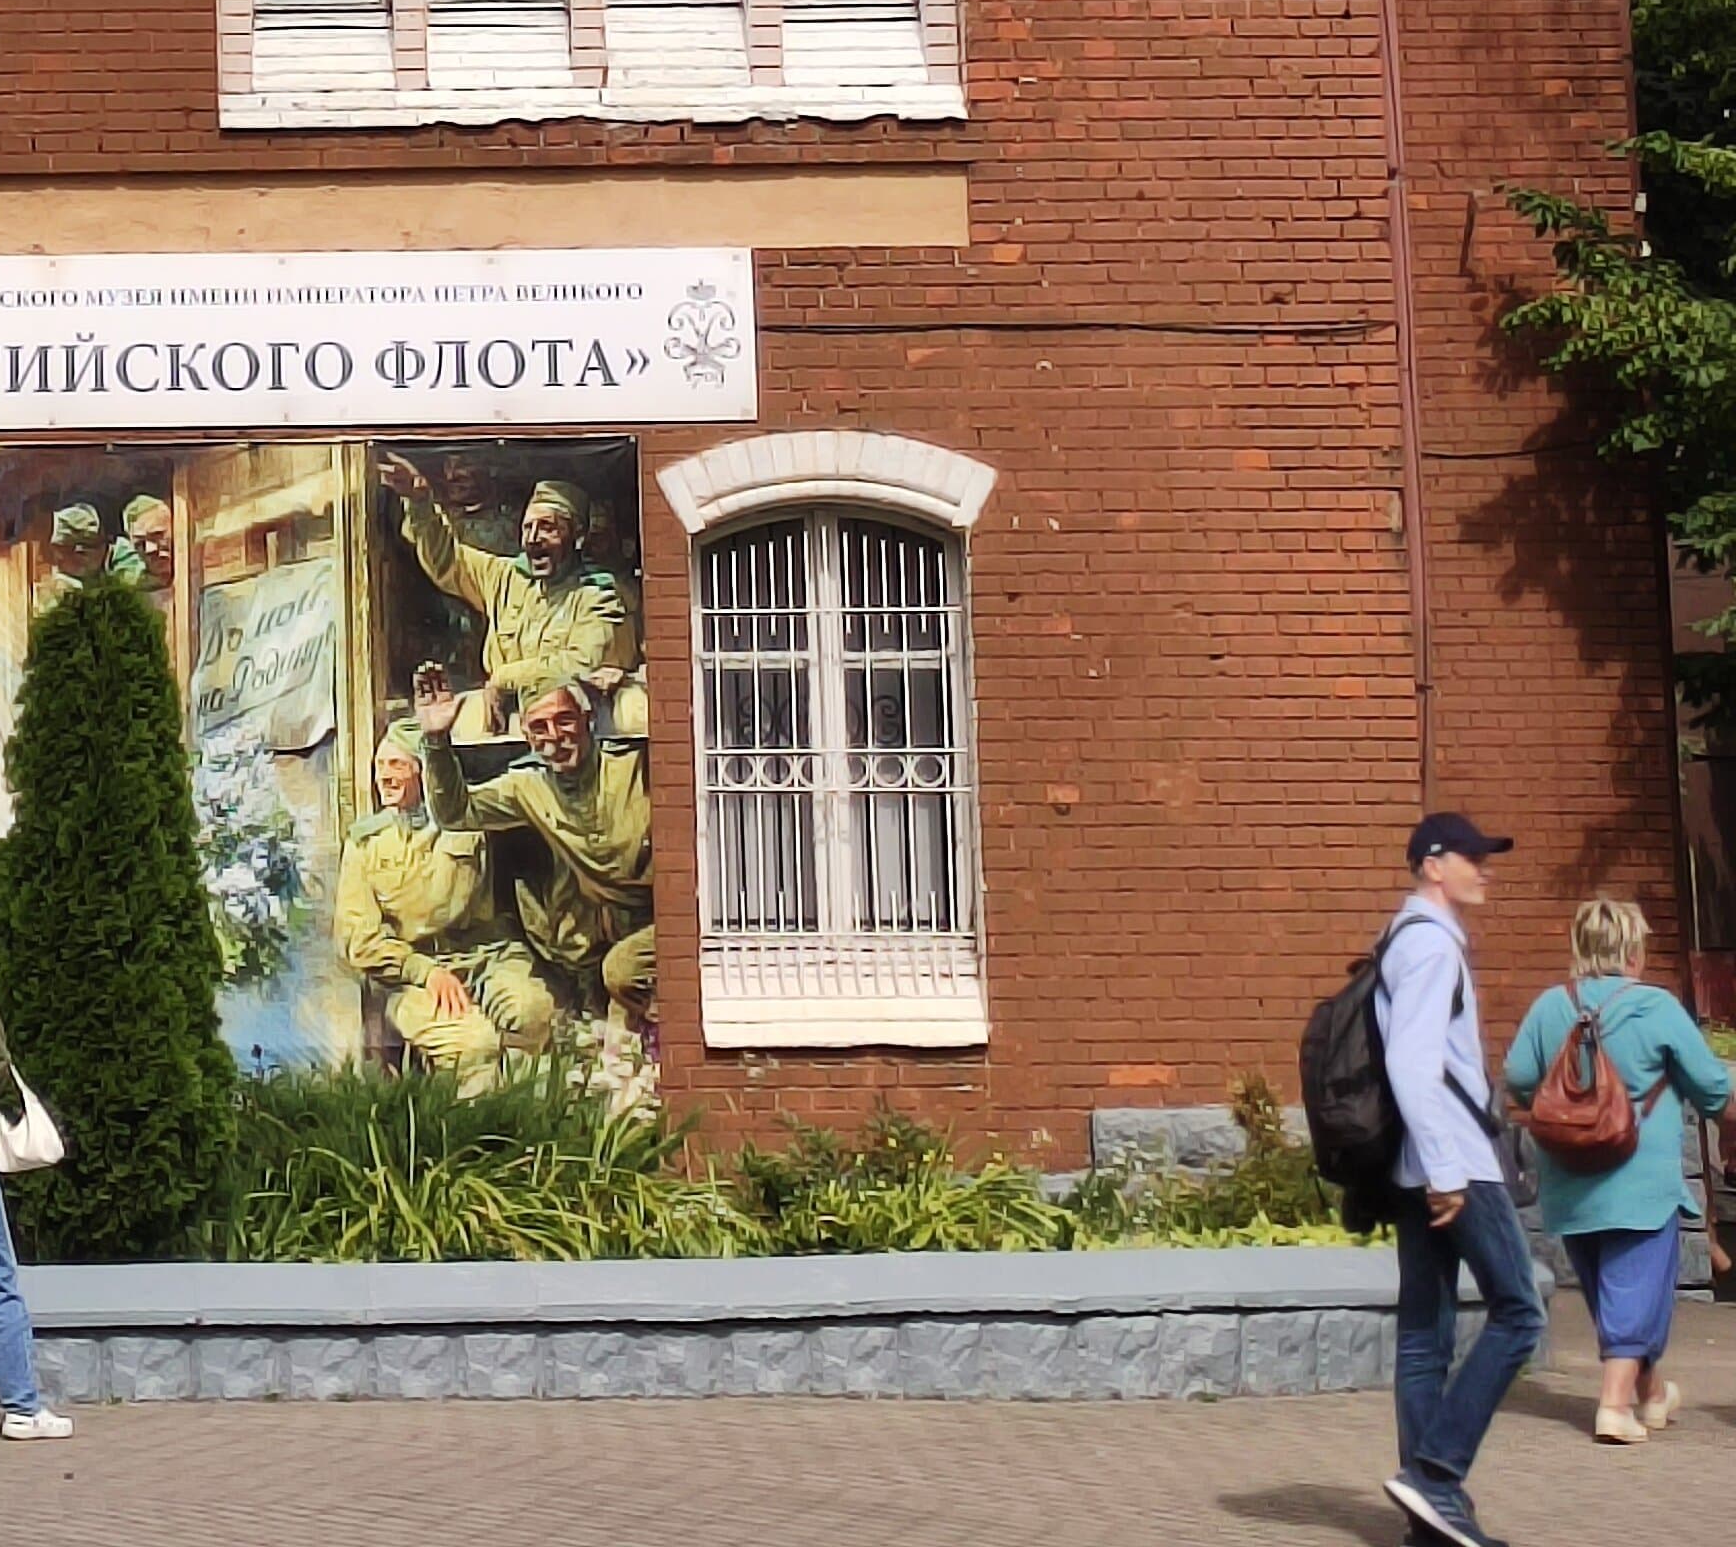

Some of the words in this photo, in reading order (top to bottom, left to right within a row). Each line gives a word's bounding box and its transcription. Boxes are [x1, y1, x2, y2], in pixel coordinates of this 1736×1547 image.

[85, 288, 162, 307] МУЗЕЯ
[170, 287, 258, 306] ИМЕНИ
[266, 285, 426, 304] ИМПЕРАТОРА
[434, 283, 509, 303] ПЕТРА
[515, 282, 644, 302] ВЕЛИКОГО
[374, 338, 651, 390] ФЛОТА»
